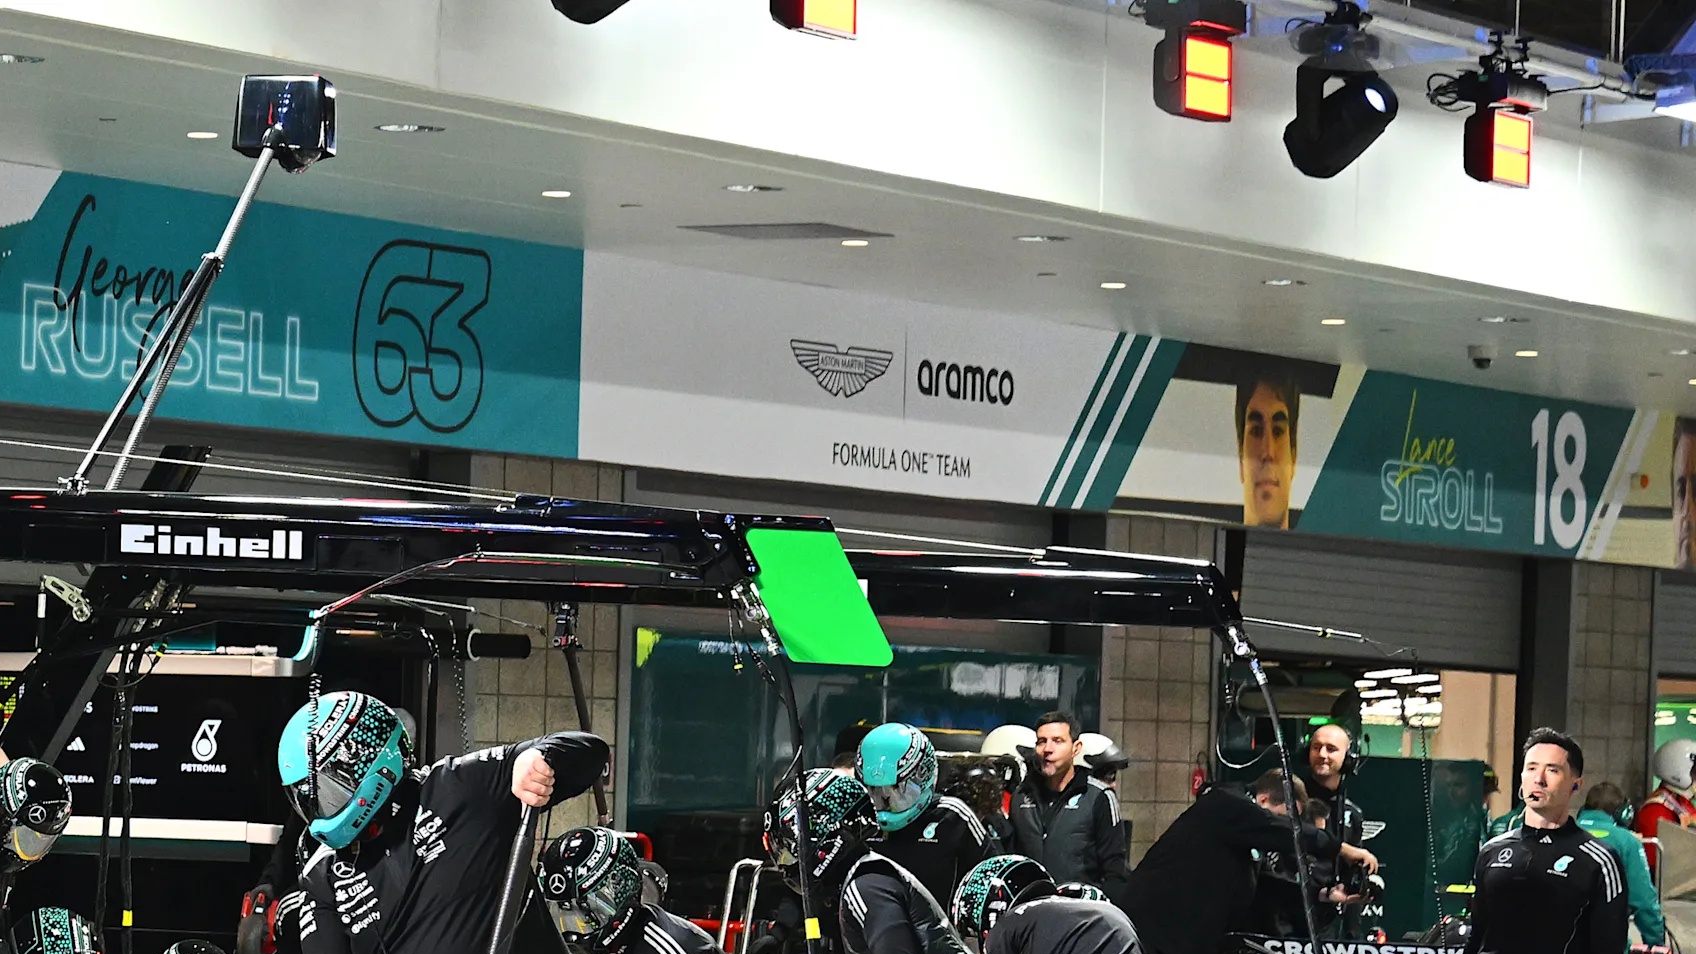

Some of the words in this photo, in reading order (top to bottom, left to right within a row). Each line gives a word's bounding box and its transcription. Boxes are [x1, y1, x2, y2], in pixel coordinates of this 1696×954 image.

[21, 283, 320, 402] RUSSELL
[352, 238, 492, 433] 63
[819, 355, 840, 369] ASTON
[841, 358, 864, 371] MARTIN
[917, 359, 1014, 406] aramco
[1394, 388, 1457, 488] Lance
[832, 442, 897, 471] FORMULA
[937, 454, 971, 478] TEAM
[1531, 408, 1587, 549] 18
[1380, 458, 1503, 534] STROLL
[120, 523, 302, 561] Einhell
[319, 698, 349, 738] SOLERA
[316, 723, 350, 763] ROWDSTRIKE
[181, 763, 227, 774] PETRONAS
[352, 782, 385, 829] Einhell
[587, 836, 607, 868] SOLERA
[813, 838, 844, 877] Einhell
